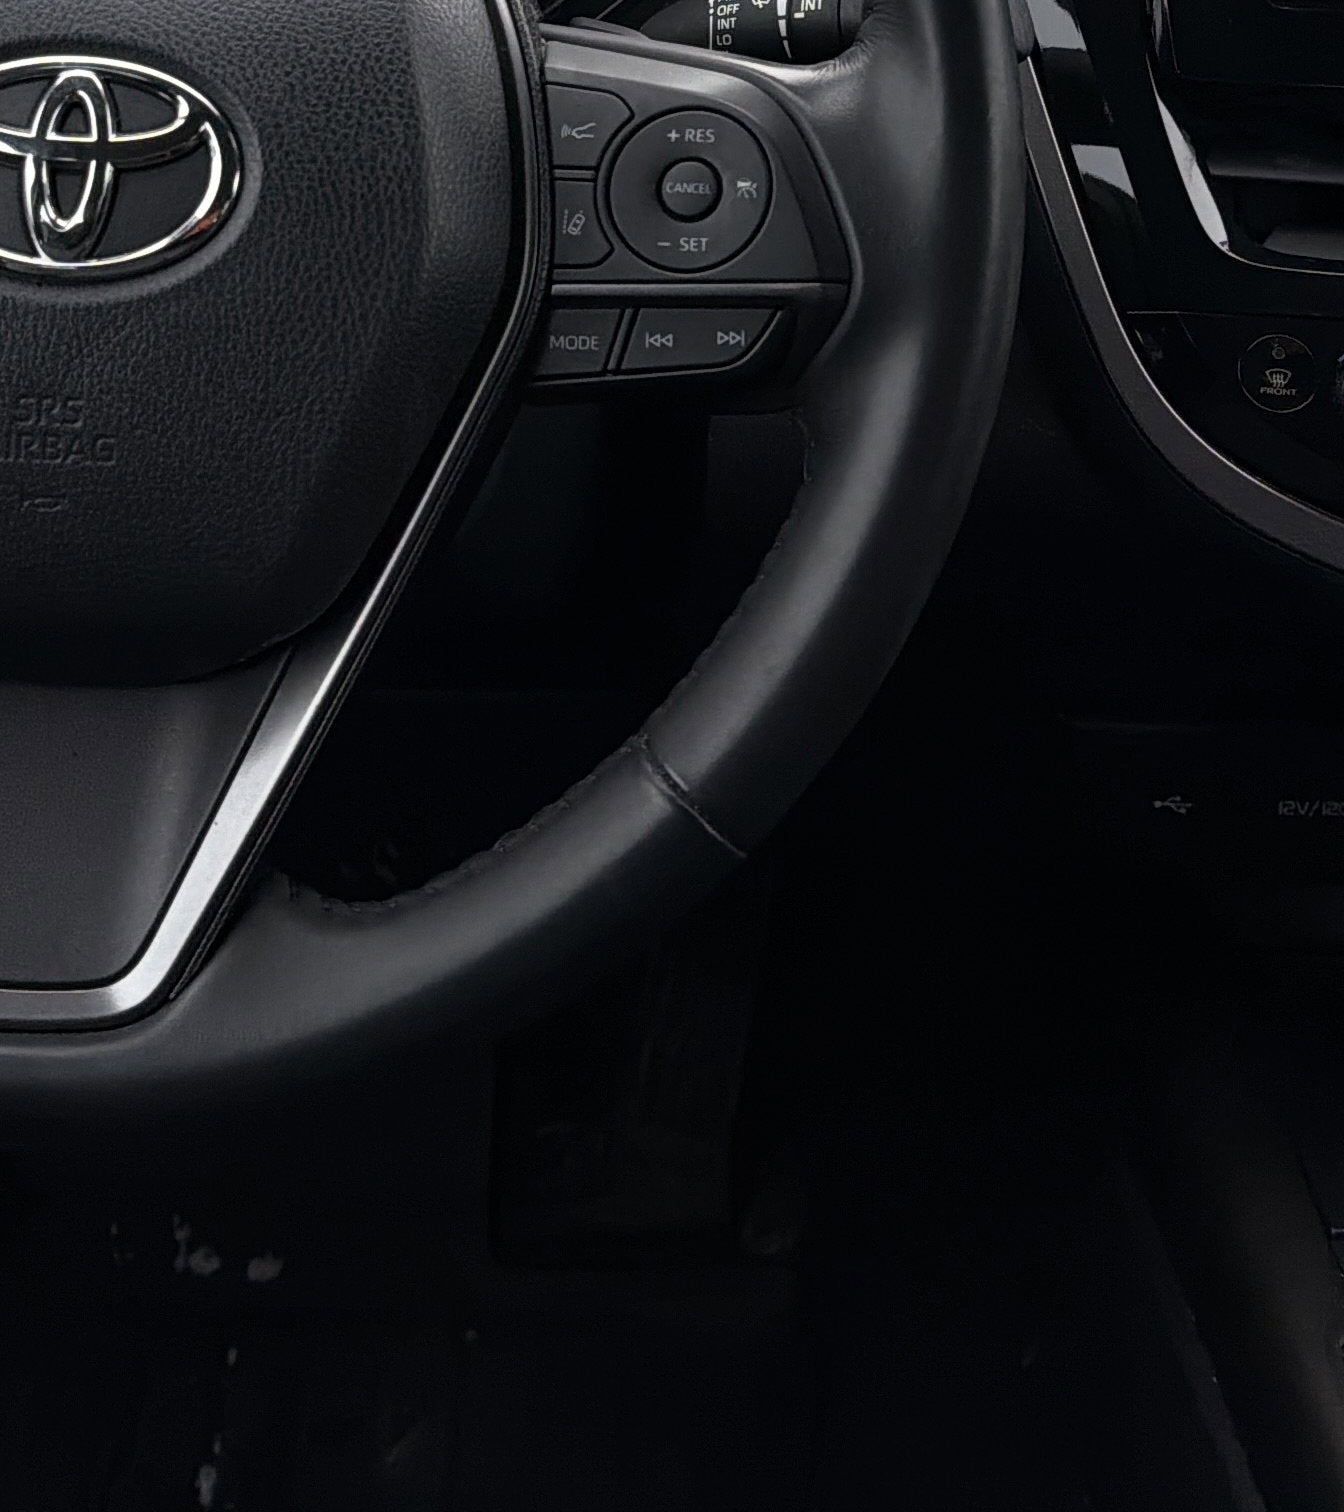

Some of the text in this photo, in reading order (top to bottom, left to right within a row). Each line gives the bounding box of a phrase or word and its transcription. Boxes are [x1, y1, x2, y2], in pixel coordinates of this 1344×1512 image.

[716, 3, 740, 17] OFF
[717, 17, 737, 31] INT
[716, 33, 733, 46] LO
[684, 129, 716, 143] RES
[665, 181, 713, 196] CANCEL
[679, 237, 709, 253] SET
[549, 335, 600, 351] MODE
[1259, 386, 1297, 396] FRONT
